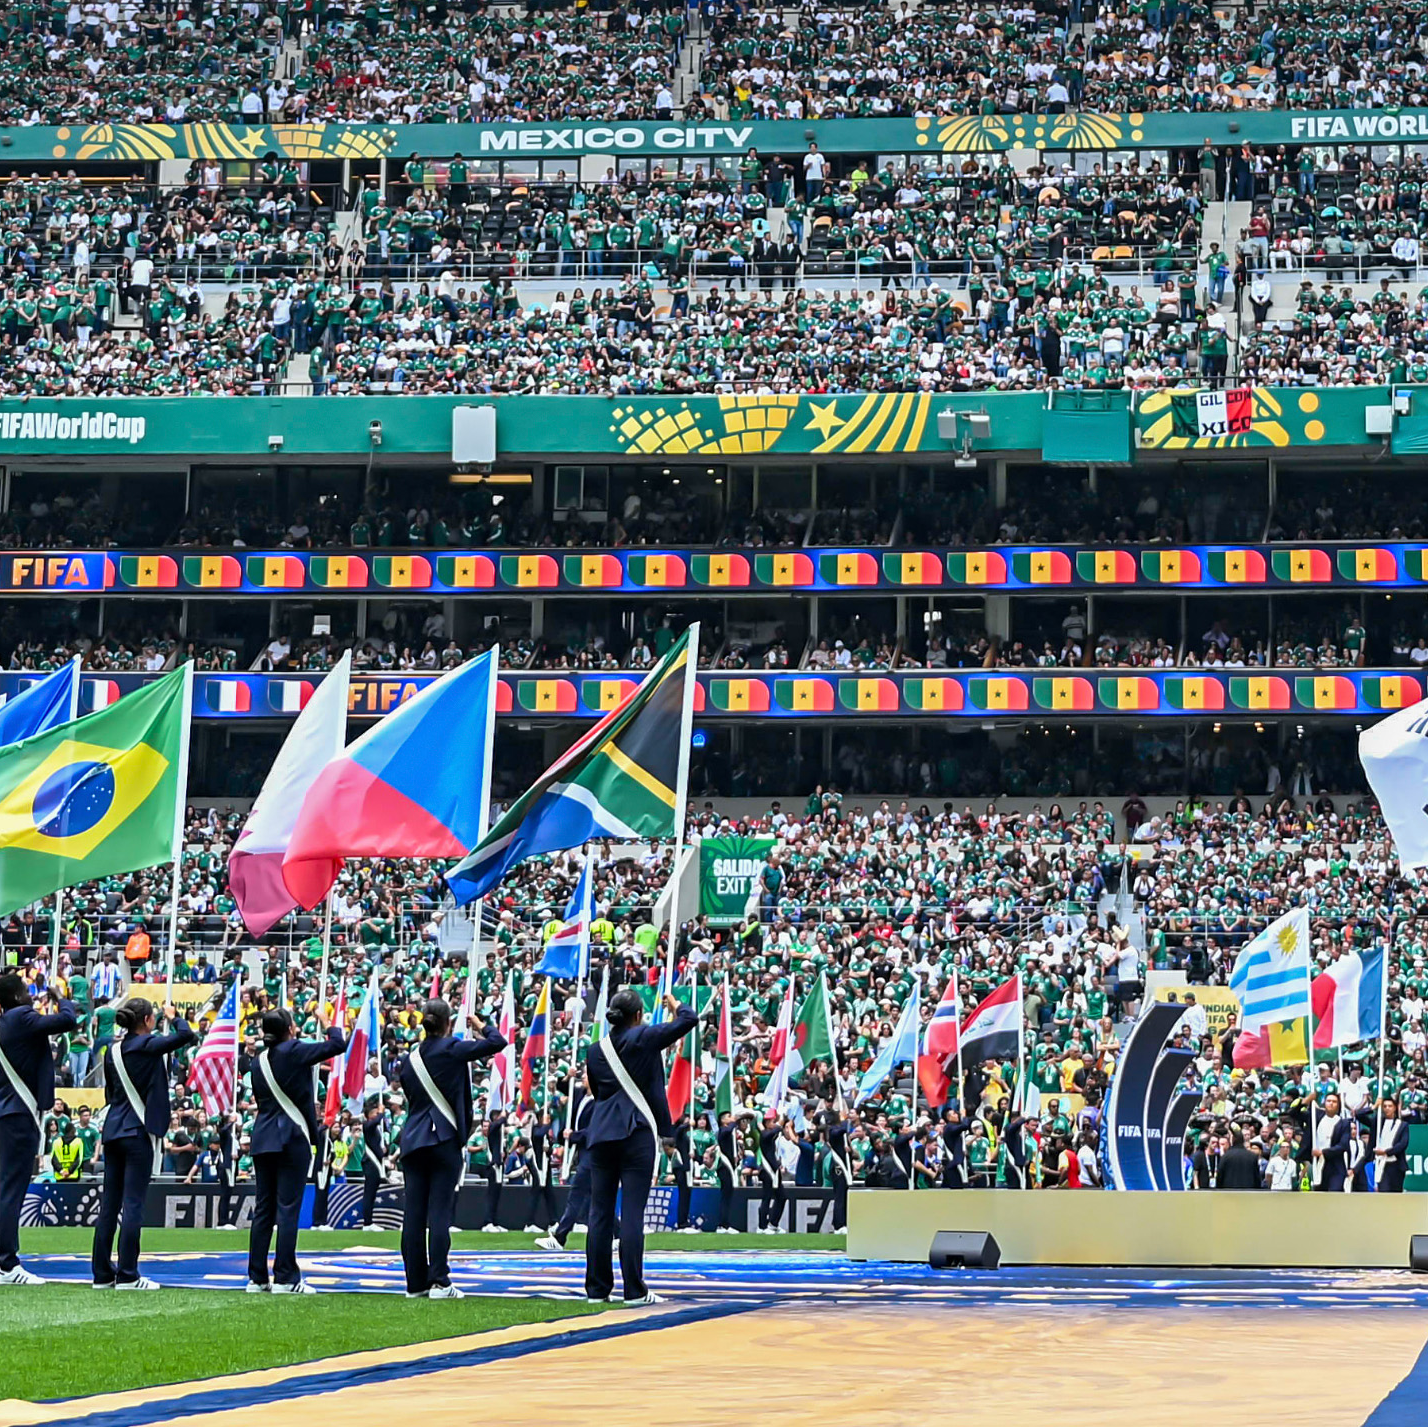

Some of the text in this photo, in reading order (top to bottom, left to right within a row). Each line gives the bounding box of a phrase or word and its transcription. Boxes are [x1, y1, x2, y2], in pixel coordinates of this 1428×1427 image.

[1291, 115, 1348, 138] FIFA
[480, 128, 753, 151] MEXICO CITY
[1200, 393, 1223, 406] GIL
[12, 557, 89, 586] FIFA
[713, 858, 761, 877] SALIDA
[717, 877, 747, 895] EXIT
[1118, 1125, 1142, 1138] FIFA
